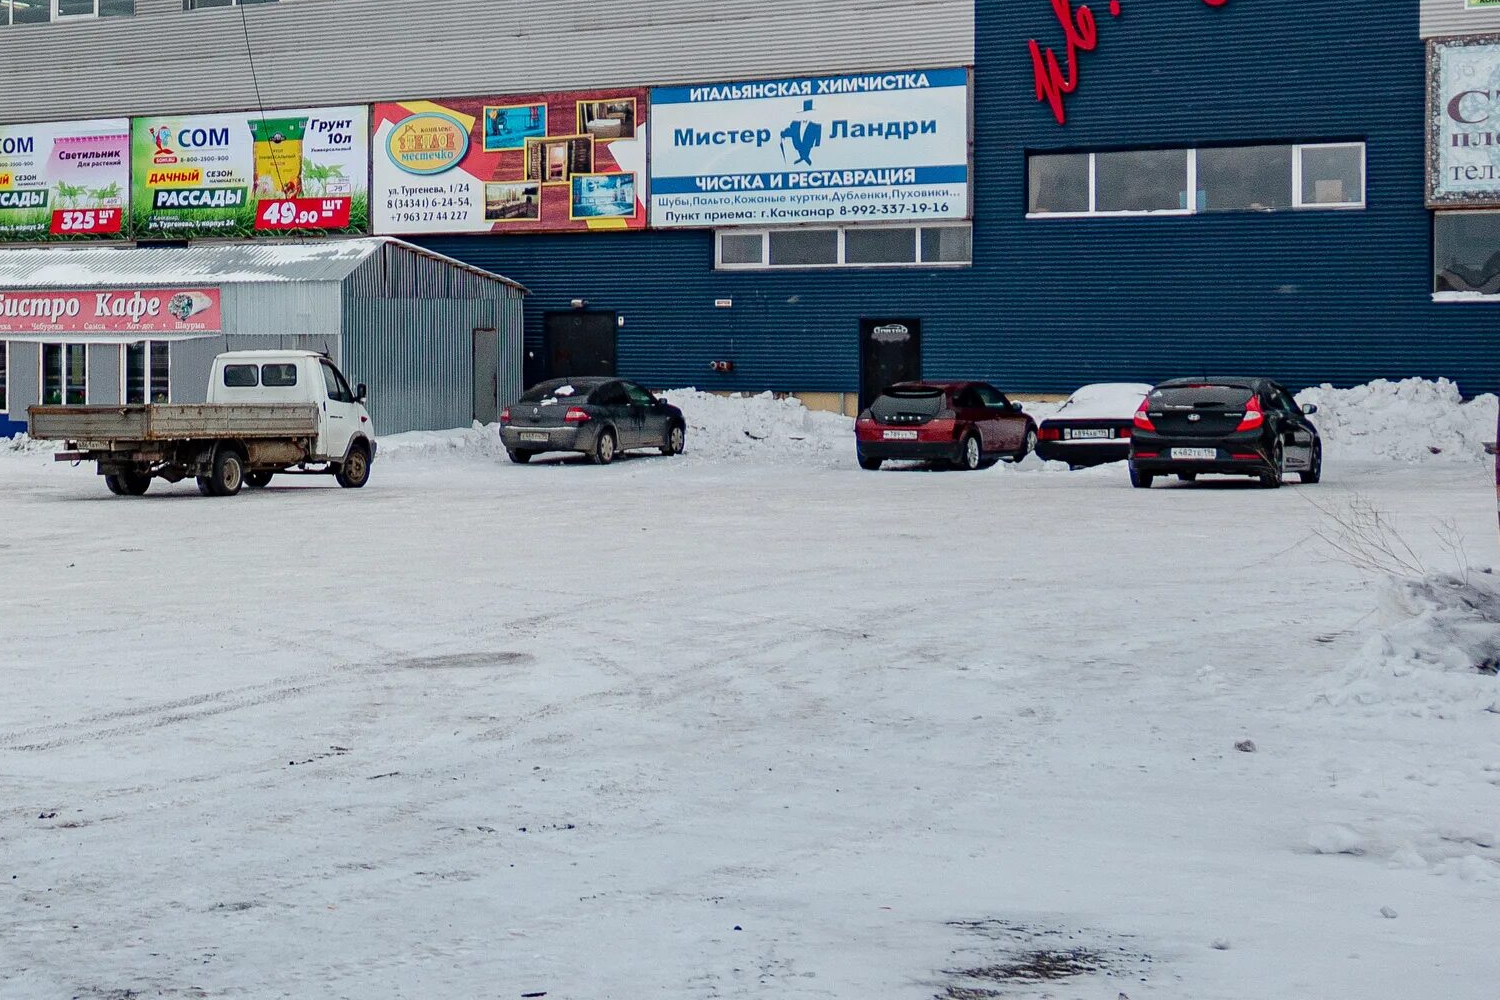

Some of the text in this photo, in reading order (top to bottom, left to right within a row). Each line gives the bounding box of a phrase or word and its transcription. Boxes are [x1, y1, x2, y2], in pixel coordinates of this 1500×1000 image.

[689, 73, 930, 101] ИТАЛЬЯНСКАЯ ХИМЧИСТКА
[310, 119, 352, 132] Грунт
[178, 127, 229, 147] СОМ
[328, 133, 352, 144] 10л
[674, 119, 937, 147] Мистер Ландри
[59, 150, 120, 160] Светильник
[401, 150, 453, 161] местечко
[91, 159, 121, 168] растений
[149, 169, 233, 184] ДАЧНЫЙ СЕЗОН
[695, 168, 916, 191] ЧИСТКА И РЕСТАВРАЦИЯ
[157, 189, 242, 207] РАССАДЫ
[388, 188, 399, 197] ул.
[401, 185, 446, 196] Тургенева,
[387, 199, 393, 208] 8
[403, 212, 420, 221] 963
[423, 212, 434, 221] 27
[436, 211, 448, 220] 44
[450, 211, 468, 220] 227
[666, 211, 700, 224] Пункт
[705, 210, 757, 222] приема:
[839, 202, 949, 216] 8-992-337-19-16
[61, 211, 94, 230] 325
[94, 291, 161, 323] Кафе
[32, 323, 64, 331] Чебуреки
[126, 322, 154, 330] Хот-дог
[175, 322, 205, 330] Шаурма
